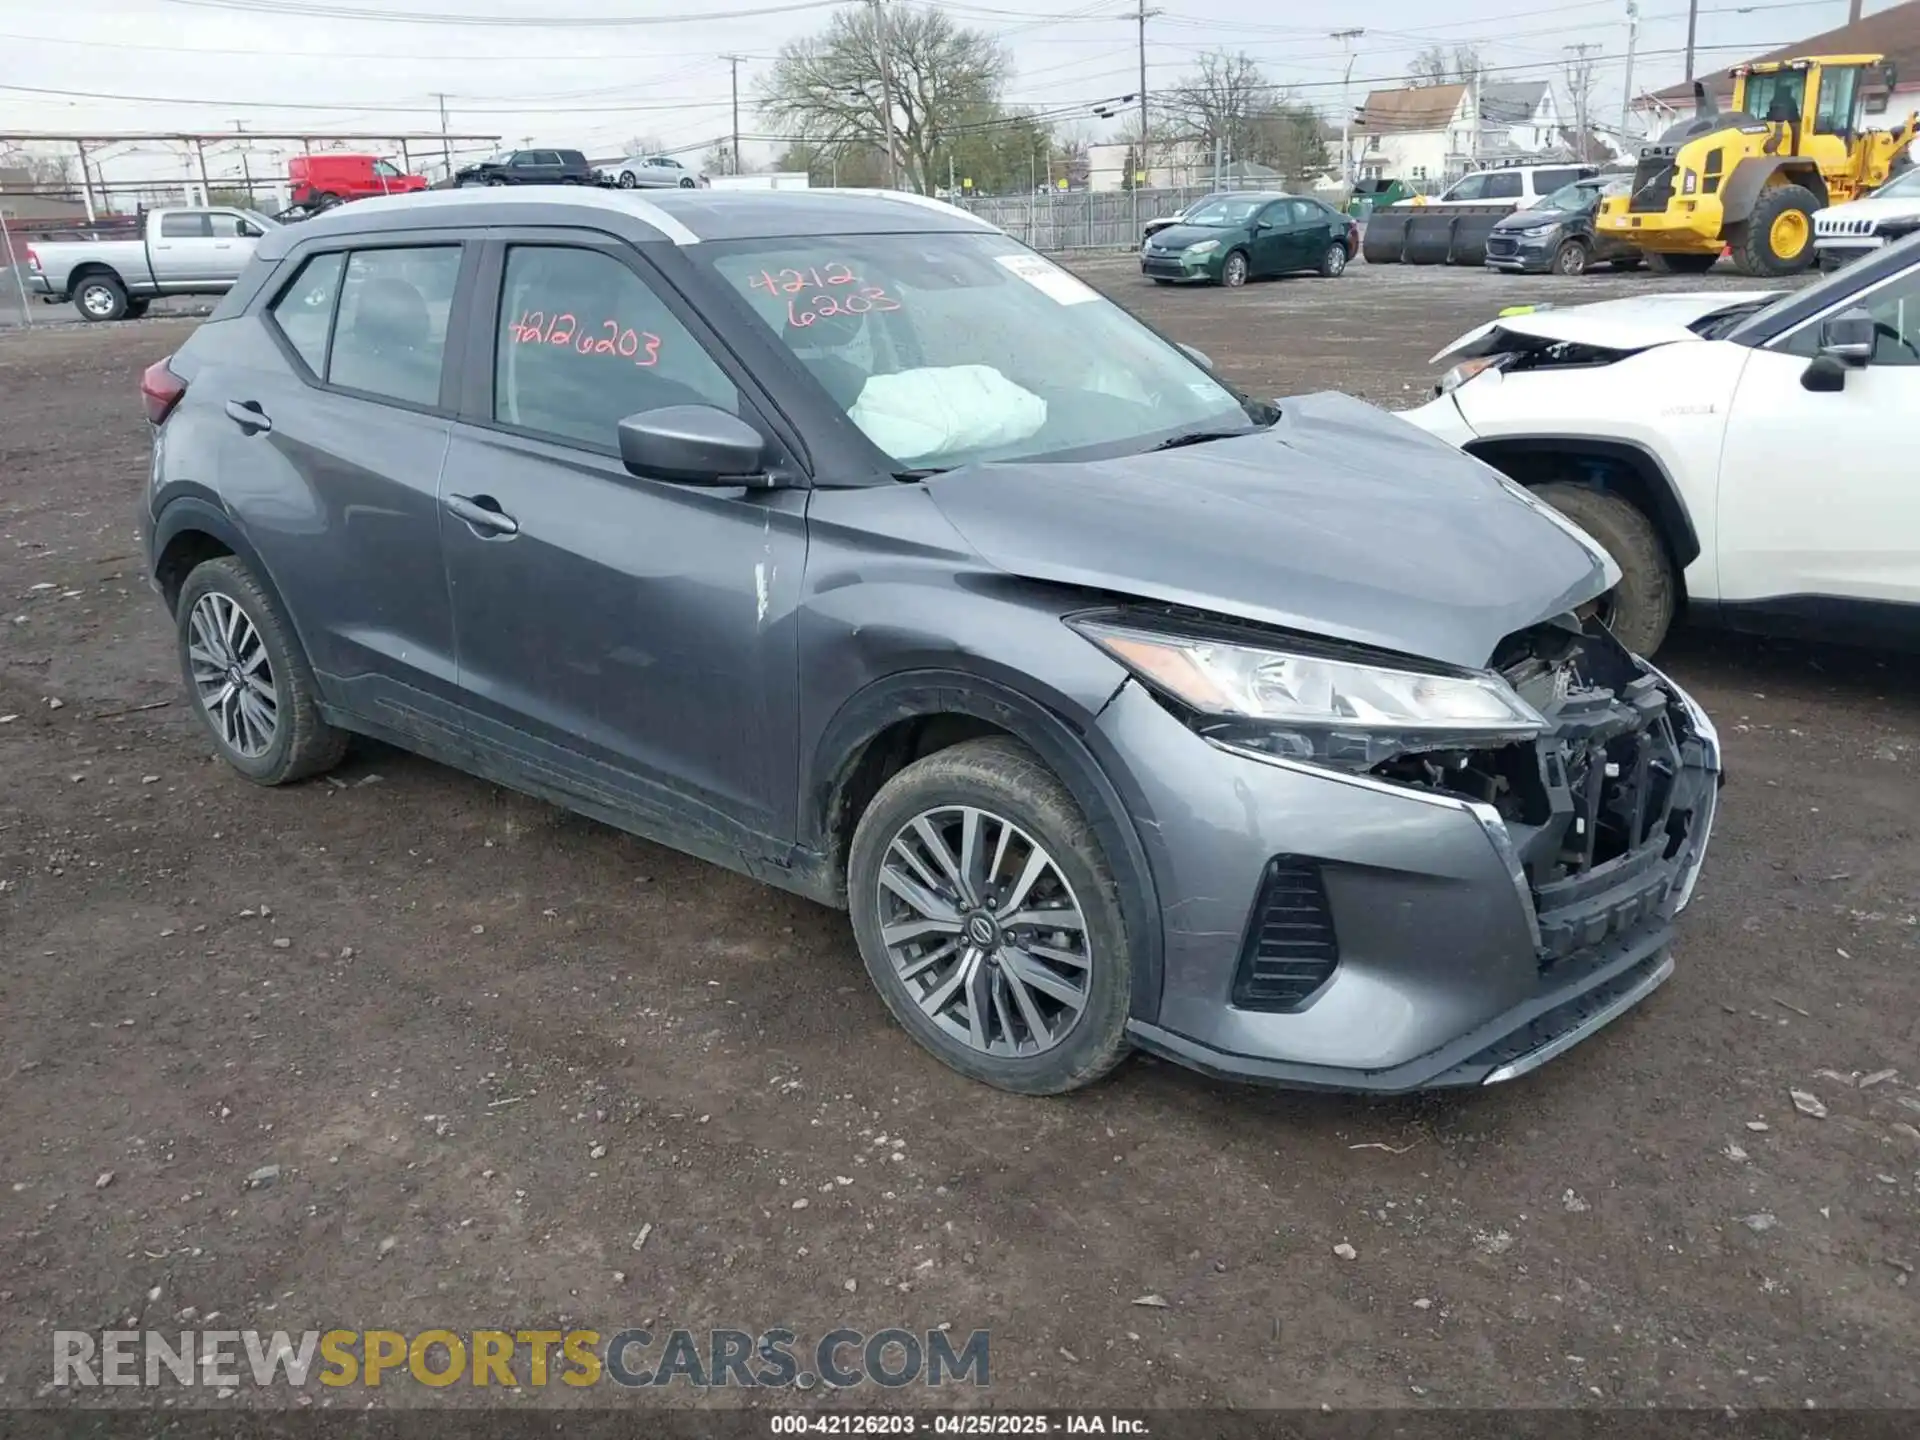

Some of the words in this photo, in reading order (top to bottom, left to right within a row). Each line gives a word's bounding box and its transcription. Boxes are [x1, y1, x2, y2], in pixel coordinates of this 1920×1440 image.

[748, 262, 860, 296] 4212
[787, 287, 901, 327] 6203
[509, 310, 661, 365] 42126203
